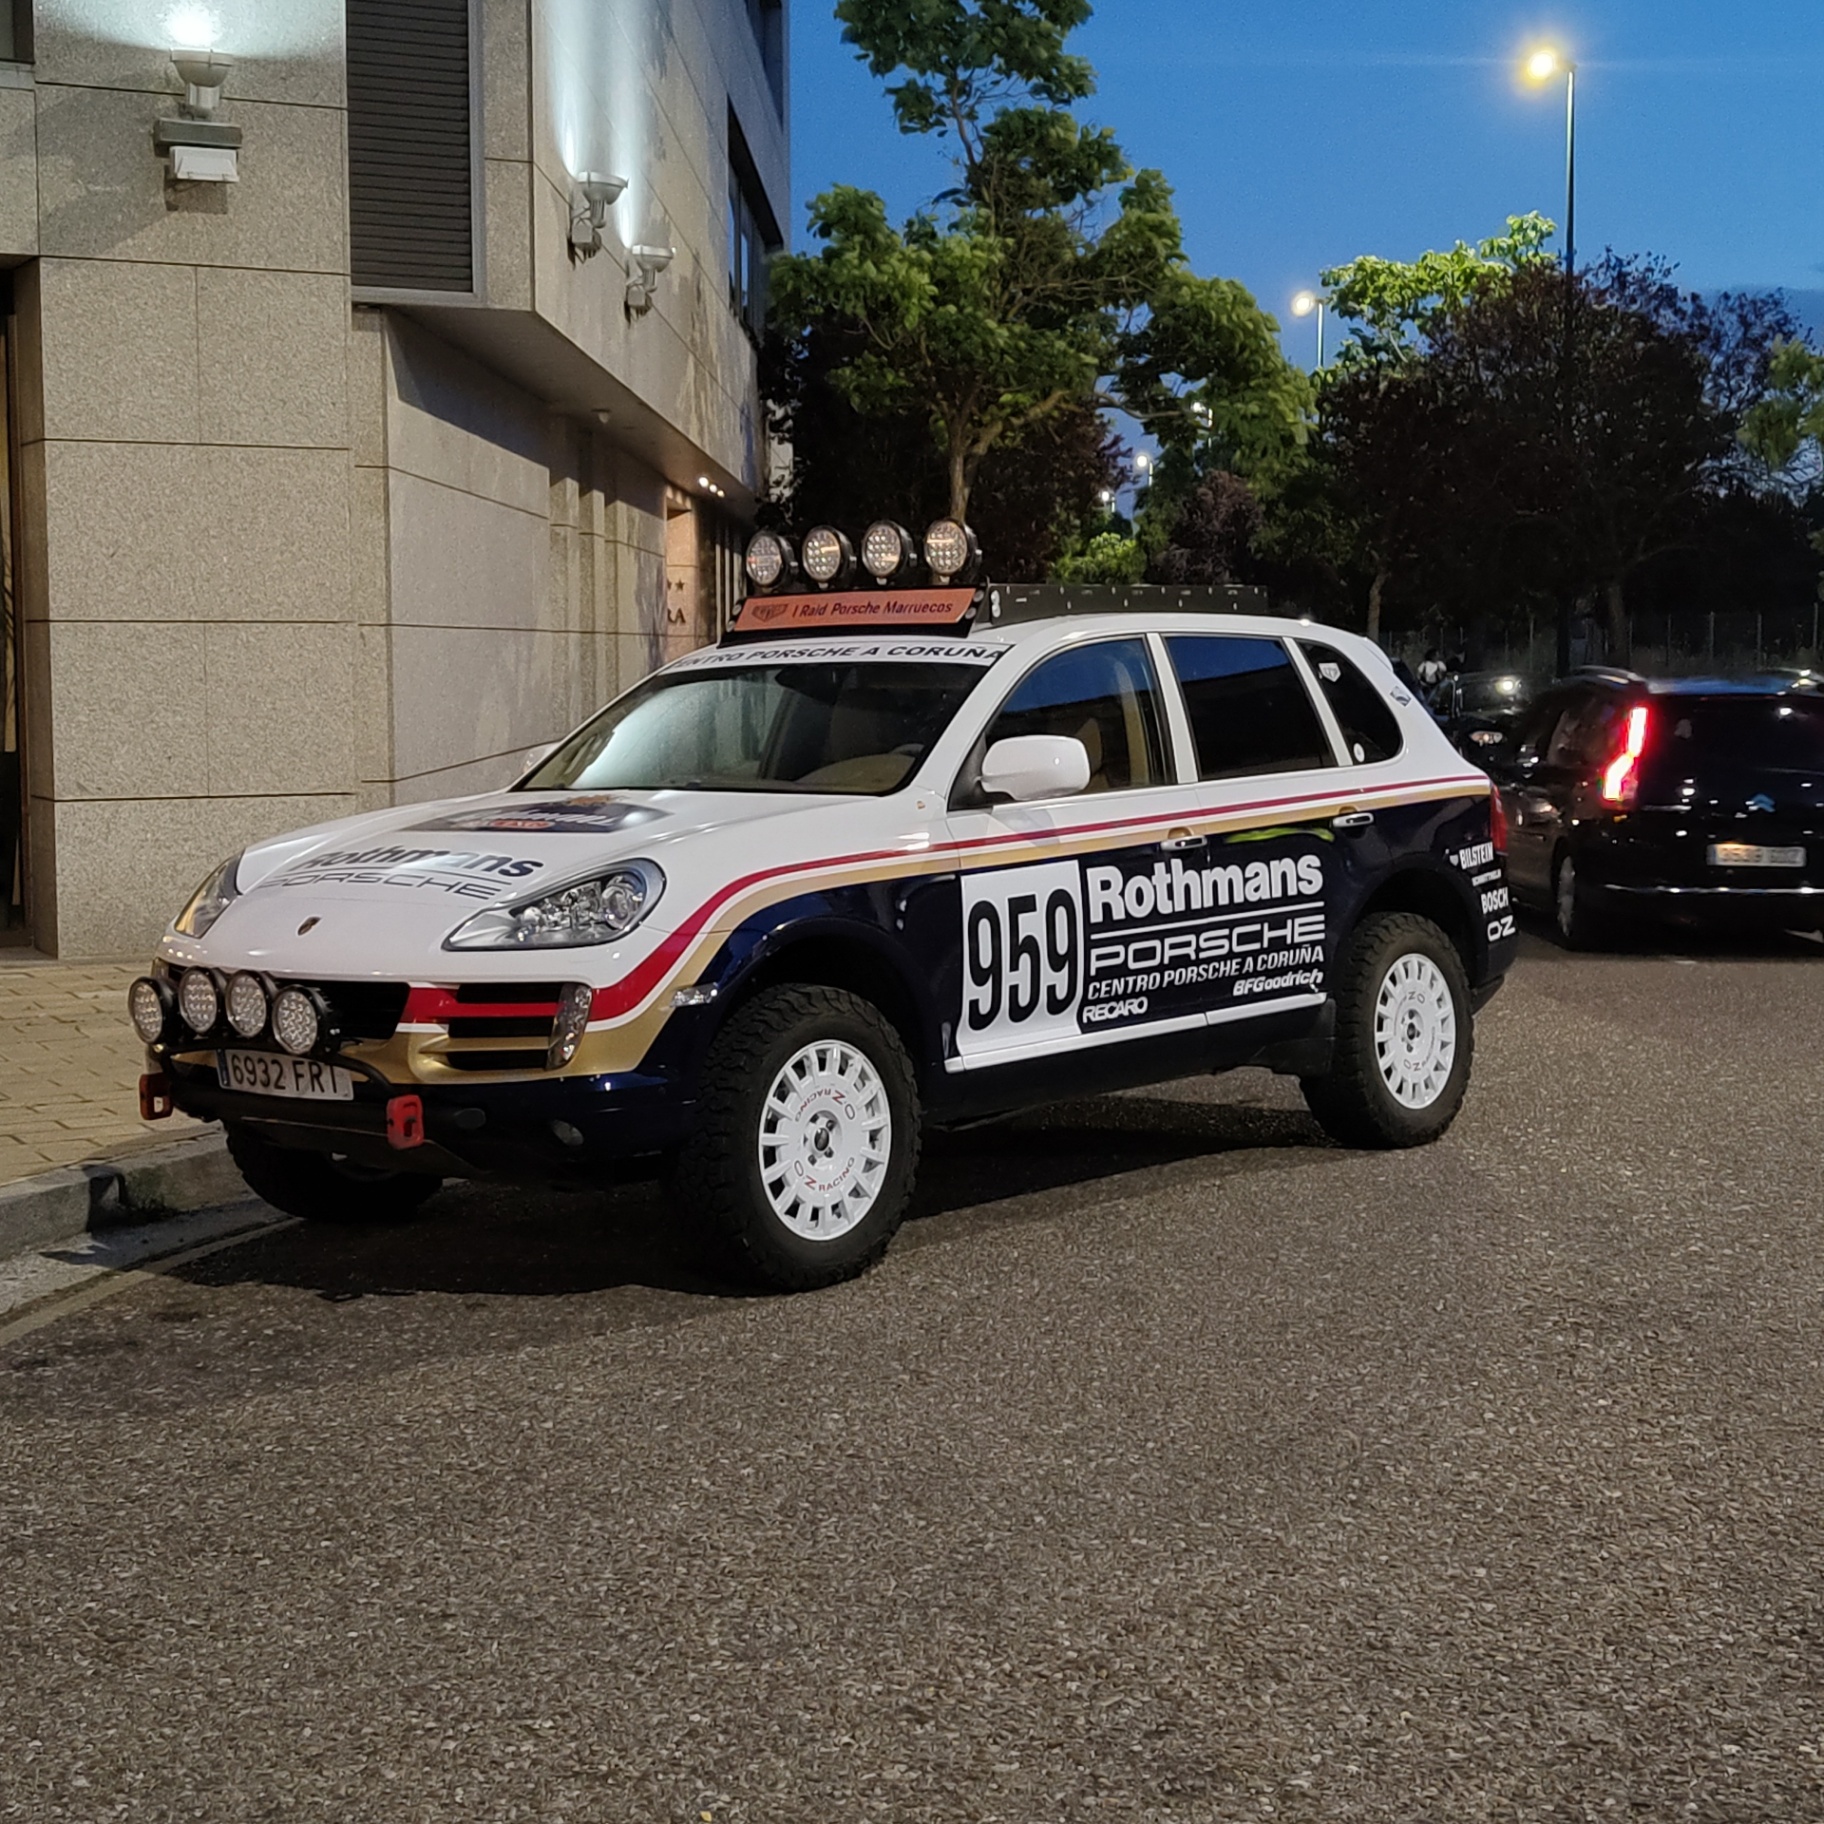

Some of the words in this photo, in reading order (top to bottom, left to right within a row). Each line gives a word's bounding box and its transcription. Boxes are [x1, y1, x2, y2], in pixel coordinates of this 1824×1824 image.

[800, 603, 827, 617] Raid
[831, 601, 880, 616] Porsche
[883, 601, 953, 615] Marruecos
[746, 646, 860, 661] PORSCHE
[860, 646, 881, 656] A
[887, 645, 1004, 659] CORUÑA
[287, 845, 544, 877] Rothmans
[1459, 841, 1494, 870] BILSTEIN
[256, 871, 502, 900] PORSCHE
[1086, 854, 1324, 923] Rothmans
[1481, 886, 1509, 914] BOSCH
[1487, 914, 1516, 942] OZ
[967, 888, 1076, 1031] 959
[1090, 914, 1326, 976] PORSCHE
[1087, 973, 1163, 1000] CENTRO
[1163, 958, 1243, 988] PORSCHE
[1242, 957, 1255, 974] A
[1256, 944, 1325, 971] CORUÑA
[1232, 968, 1324, 997] BFGoodrich
[1082, 996, 1149, 1023] RECARO
[231, 1054, 286, 1091] 6932
[795, 1088, 831, 1122] RACING
[819, 1157, 855, 1192] RACING
